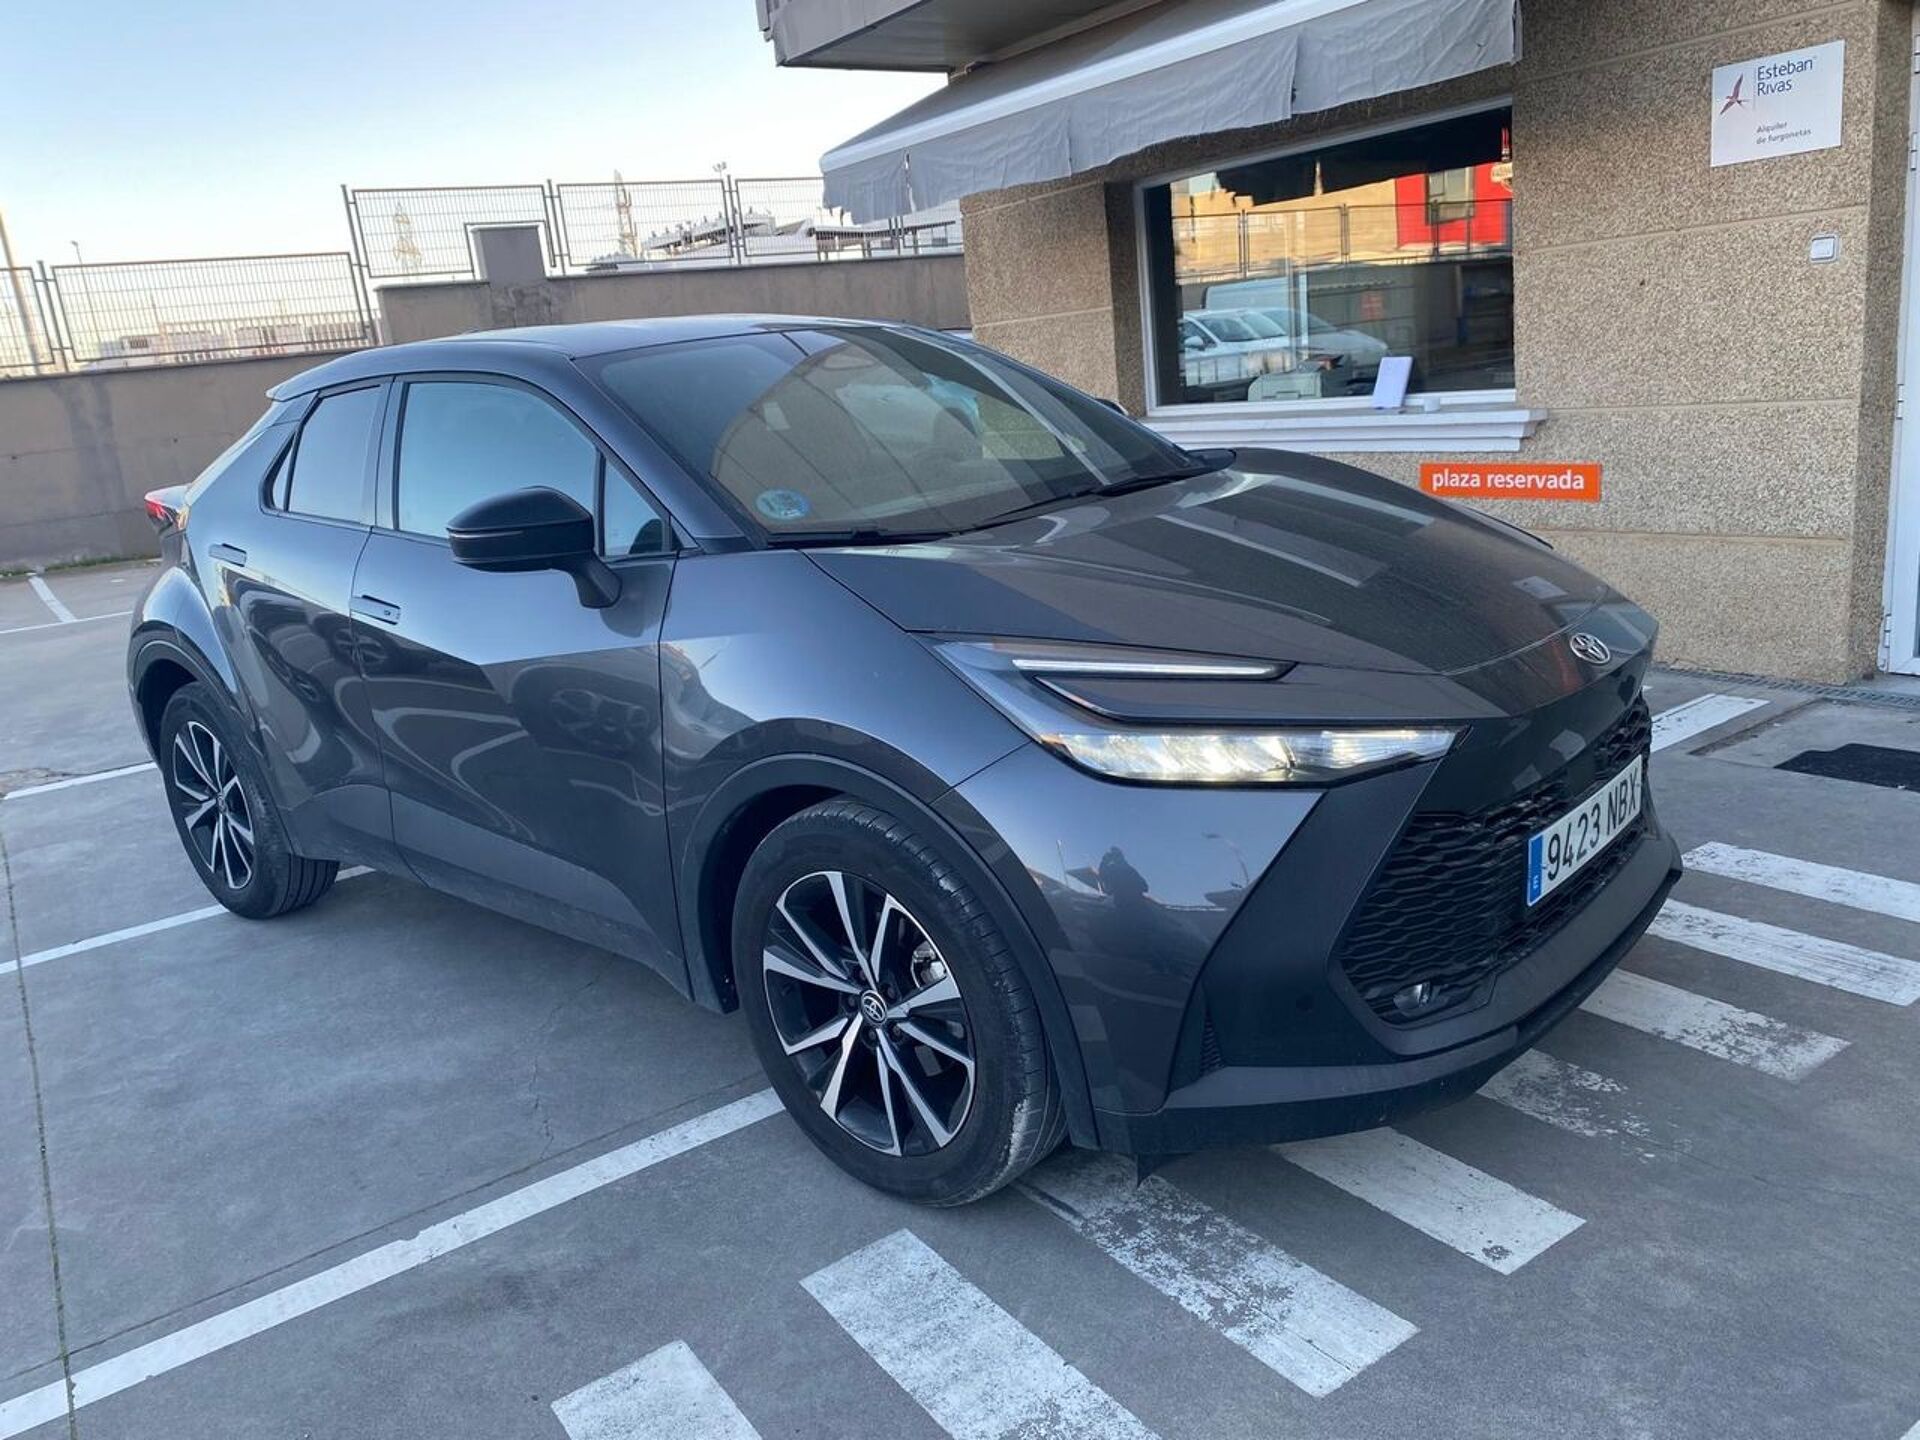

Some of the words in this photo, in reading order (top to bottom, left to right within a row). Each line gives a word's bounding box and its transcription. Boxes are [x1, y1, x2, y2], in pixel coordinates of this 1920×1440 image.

[1757, 59, 1813, 81] Esteban
[1757, 79, 1792, 96] Rivas
[1756, 121, 1788, 134] Alquiler
[1756, 135, 1767, 145] de
[1768, 128, 1812, 143] furgonetas
[1432, 468, 1481, 492] plaza
[1487, 469, 1585, 490] reservada
[1547, 802, 1601, 881] 9423
[1606, 767, 1639, 836] NBX
